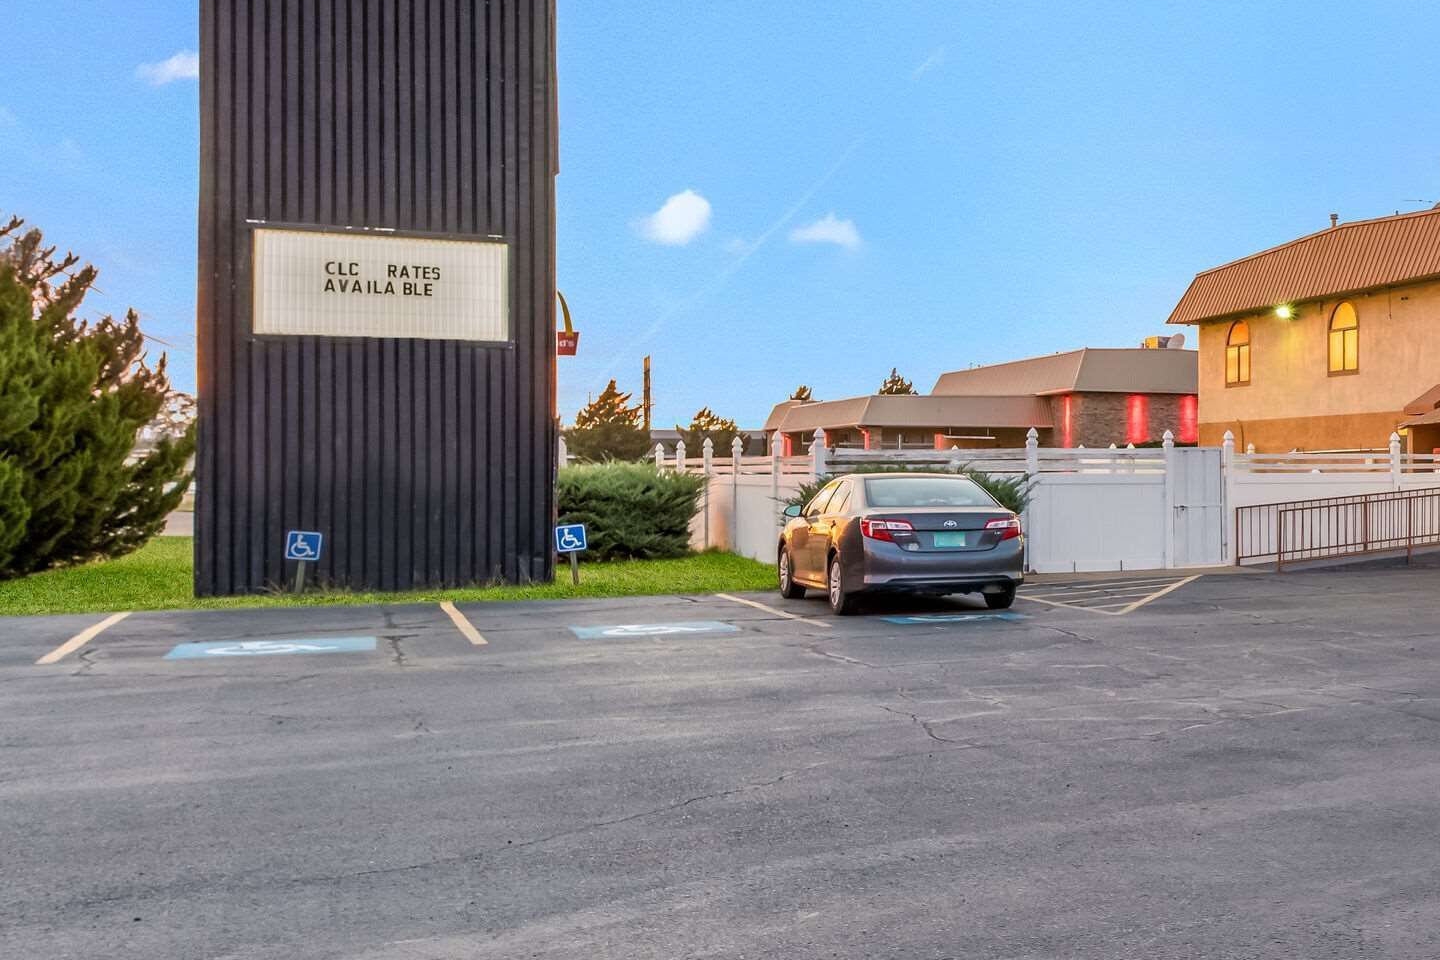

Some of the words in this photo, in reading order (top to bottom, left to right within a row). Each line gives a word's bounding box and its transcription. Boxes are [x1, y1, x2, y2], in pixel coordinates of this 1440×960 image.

[325, 261, 359, 276] CLC
[387, 264, 441, 280] RATES
[324, 278, 433, 297] AVAILABLE
